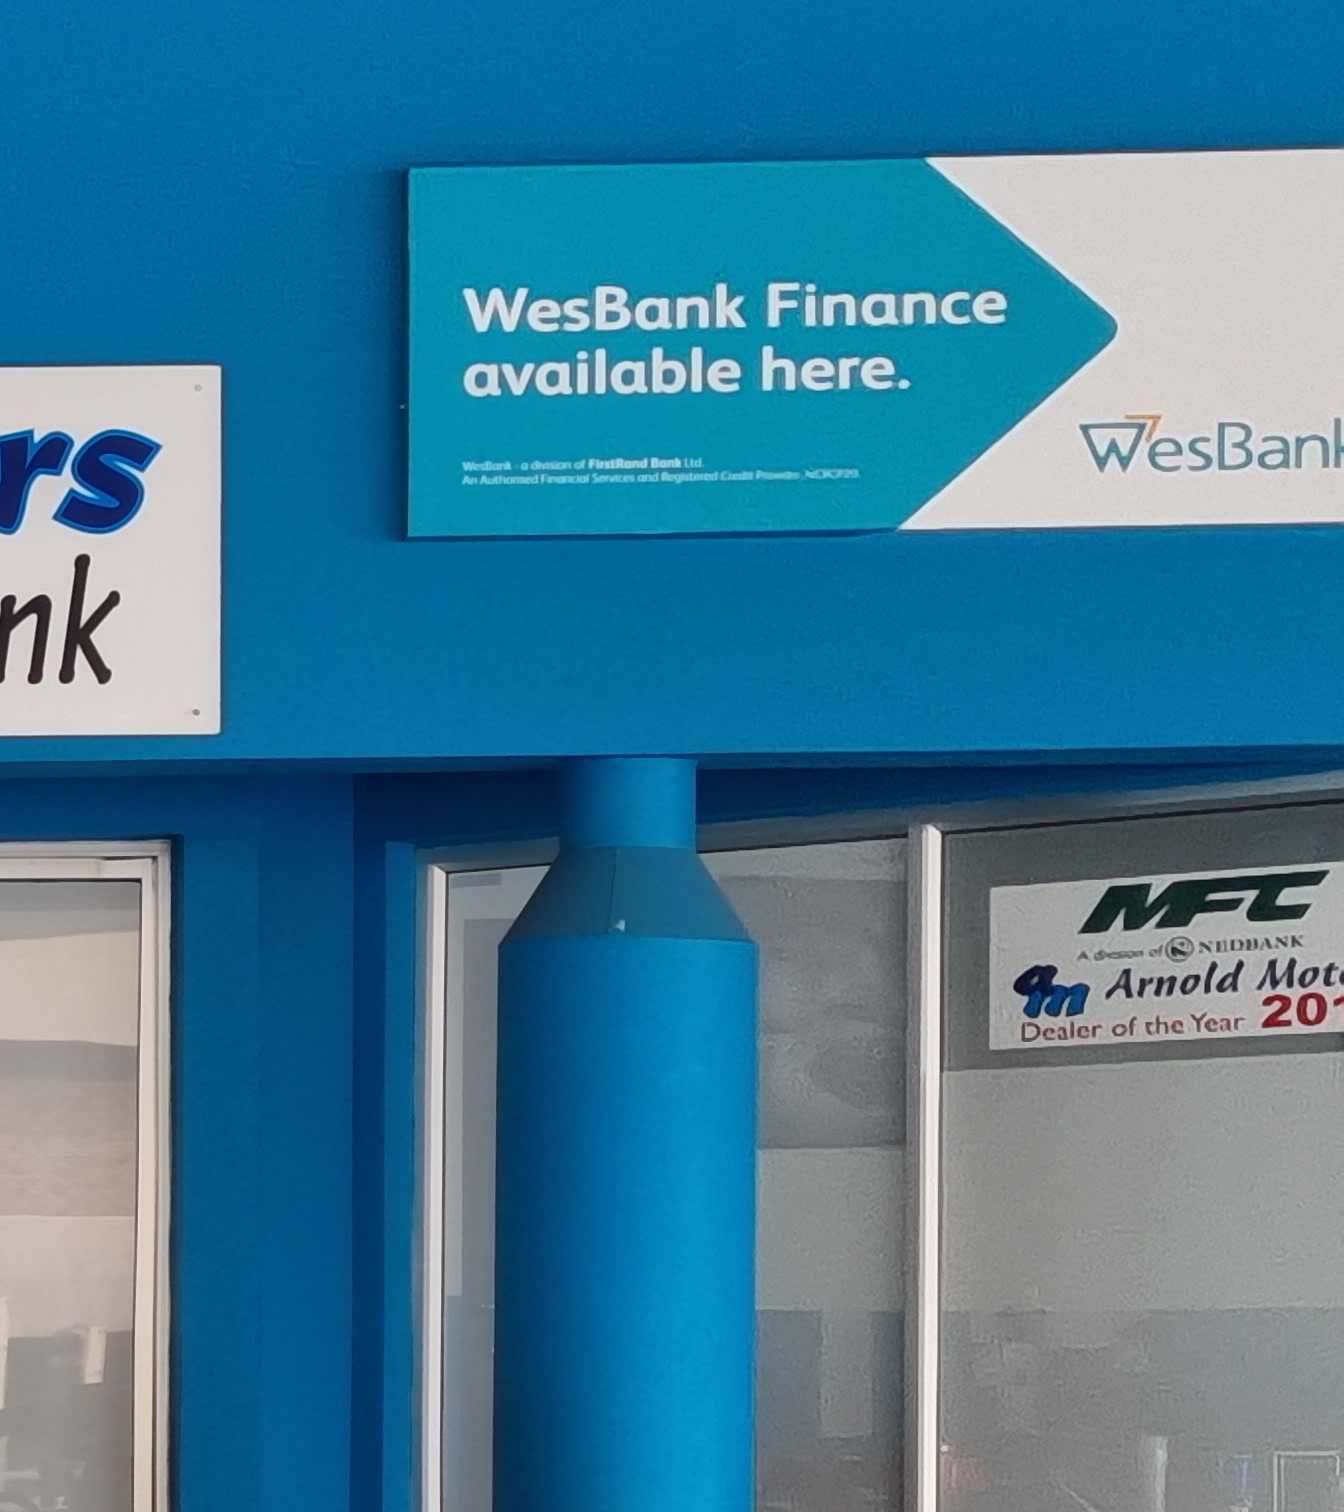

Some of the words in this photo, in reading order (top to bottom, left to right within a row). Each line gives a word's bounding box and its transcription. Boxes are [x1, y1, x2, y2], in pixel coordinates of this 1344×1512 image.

[462, 283, 747, 333] WesBank
[767, 282, 1008, 329] Finance
[463, 346, 742, 397] available
[761, 345, 912, 392] here.
[462, 461, 512, 472] WesBank
[530, 460, 572, 470] division
[588, 457, 648, 470] FirstRand
[650, 457, 681, 469] Bank
[462, 475, 478, 485] An
[540, 474, 590, 484] Financial
[591, 473, 635, 484] Services
[637, 472, 659, 483] and
[662, 471, 718, 484] Registered
[1078, 870, 1329, 934] MFC
[1105, 958, 1245, 1000] Arnold
[1021, 1021, 1103, 1043] Dealer
[1112, 1016, 1138, 1038] of
[1145, 1014, 1184, 1036] the
[1190, 1012, 1246, 1033] Year
